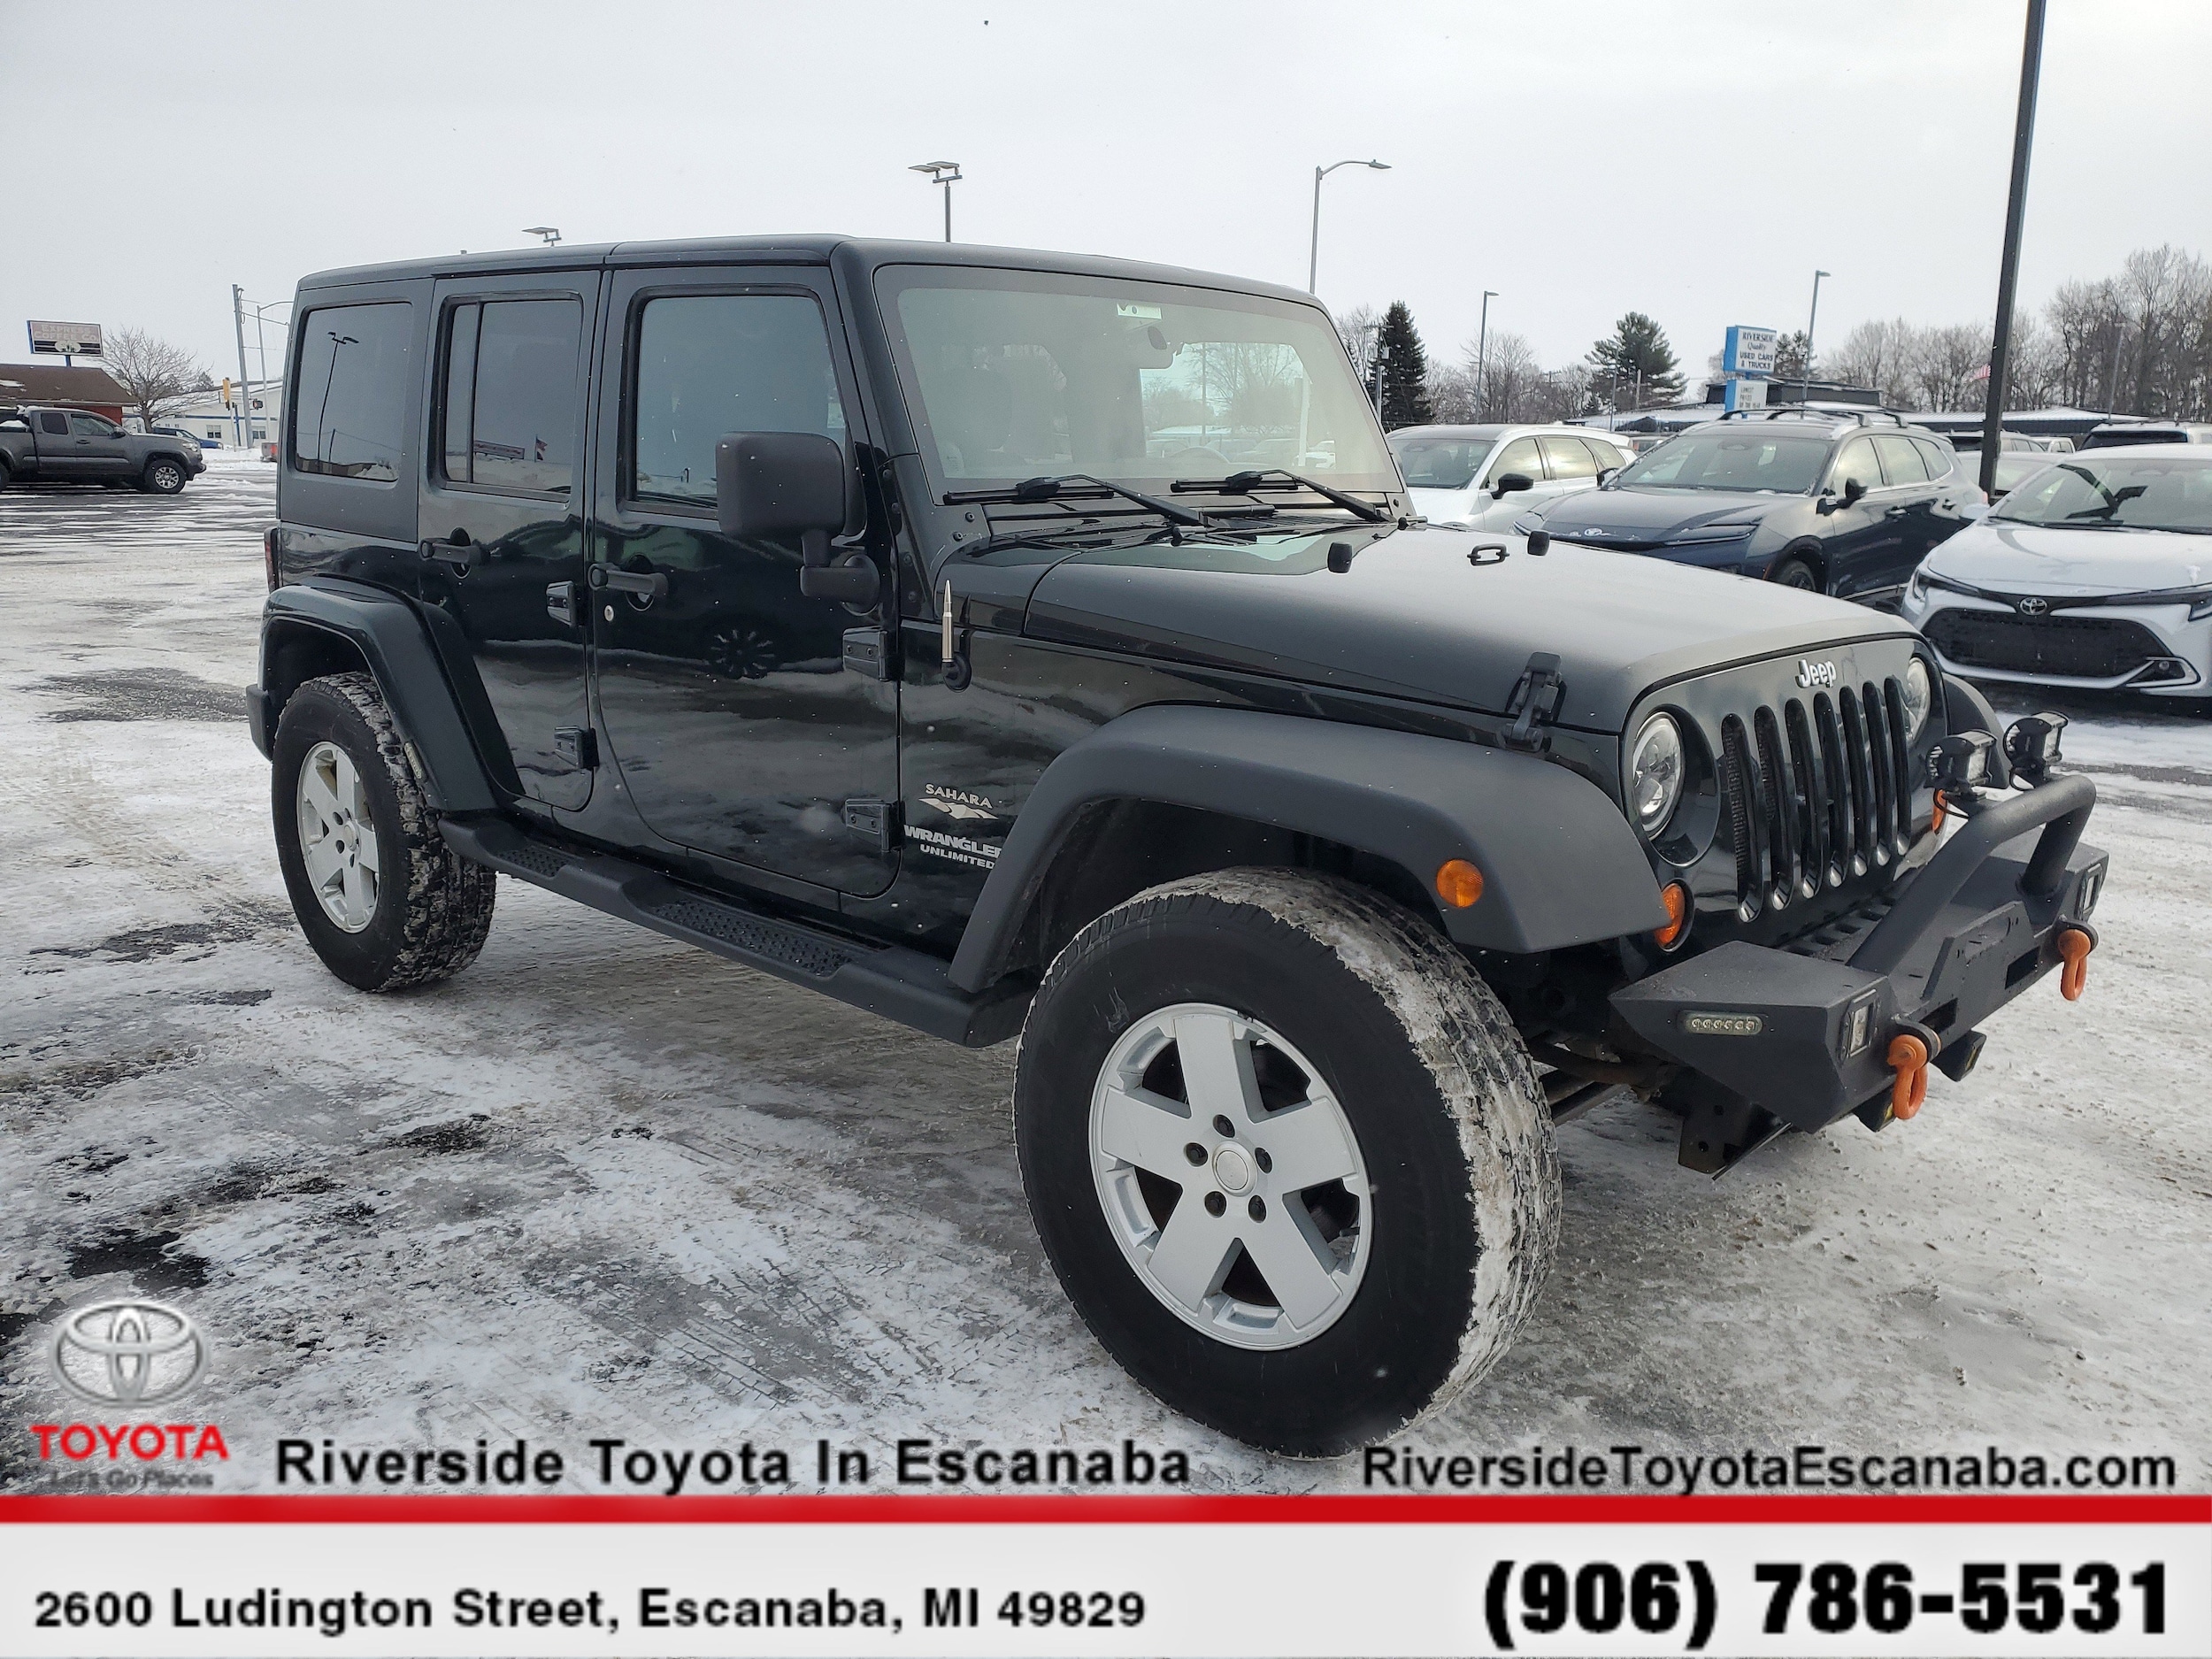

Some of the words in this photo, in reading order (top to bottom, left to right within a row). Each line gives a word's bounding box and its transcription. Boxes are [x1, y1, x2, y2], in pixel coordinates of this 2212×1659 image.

[42, 324, 91, 334] EXPRESS
[35, 331, 77, 341] COFFEE
[1742, 332, 1775, 342] RIVERSIDE
[1740, 350, 1755, 359] USED
[1758, 352, 1773, 362] CARS
[1748, 361, 1771, 370] TRUCKS
[1794, 658, 1837, 688] Jeep
[925, 783, 993, 810] SAHARA
[920, 843, 995, 870] UNLIMITED
